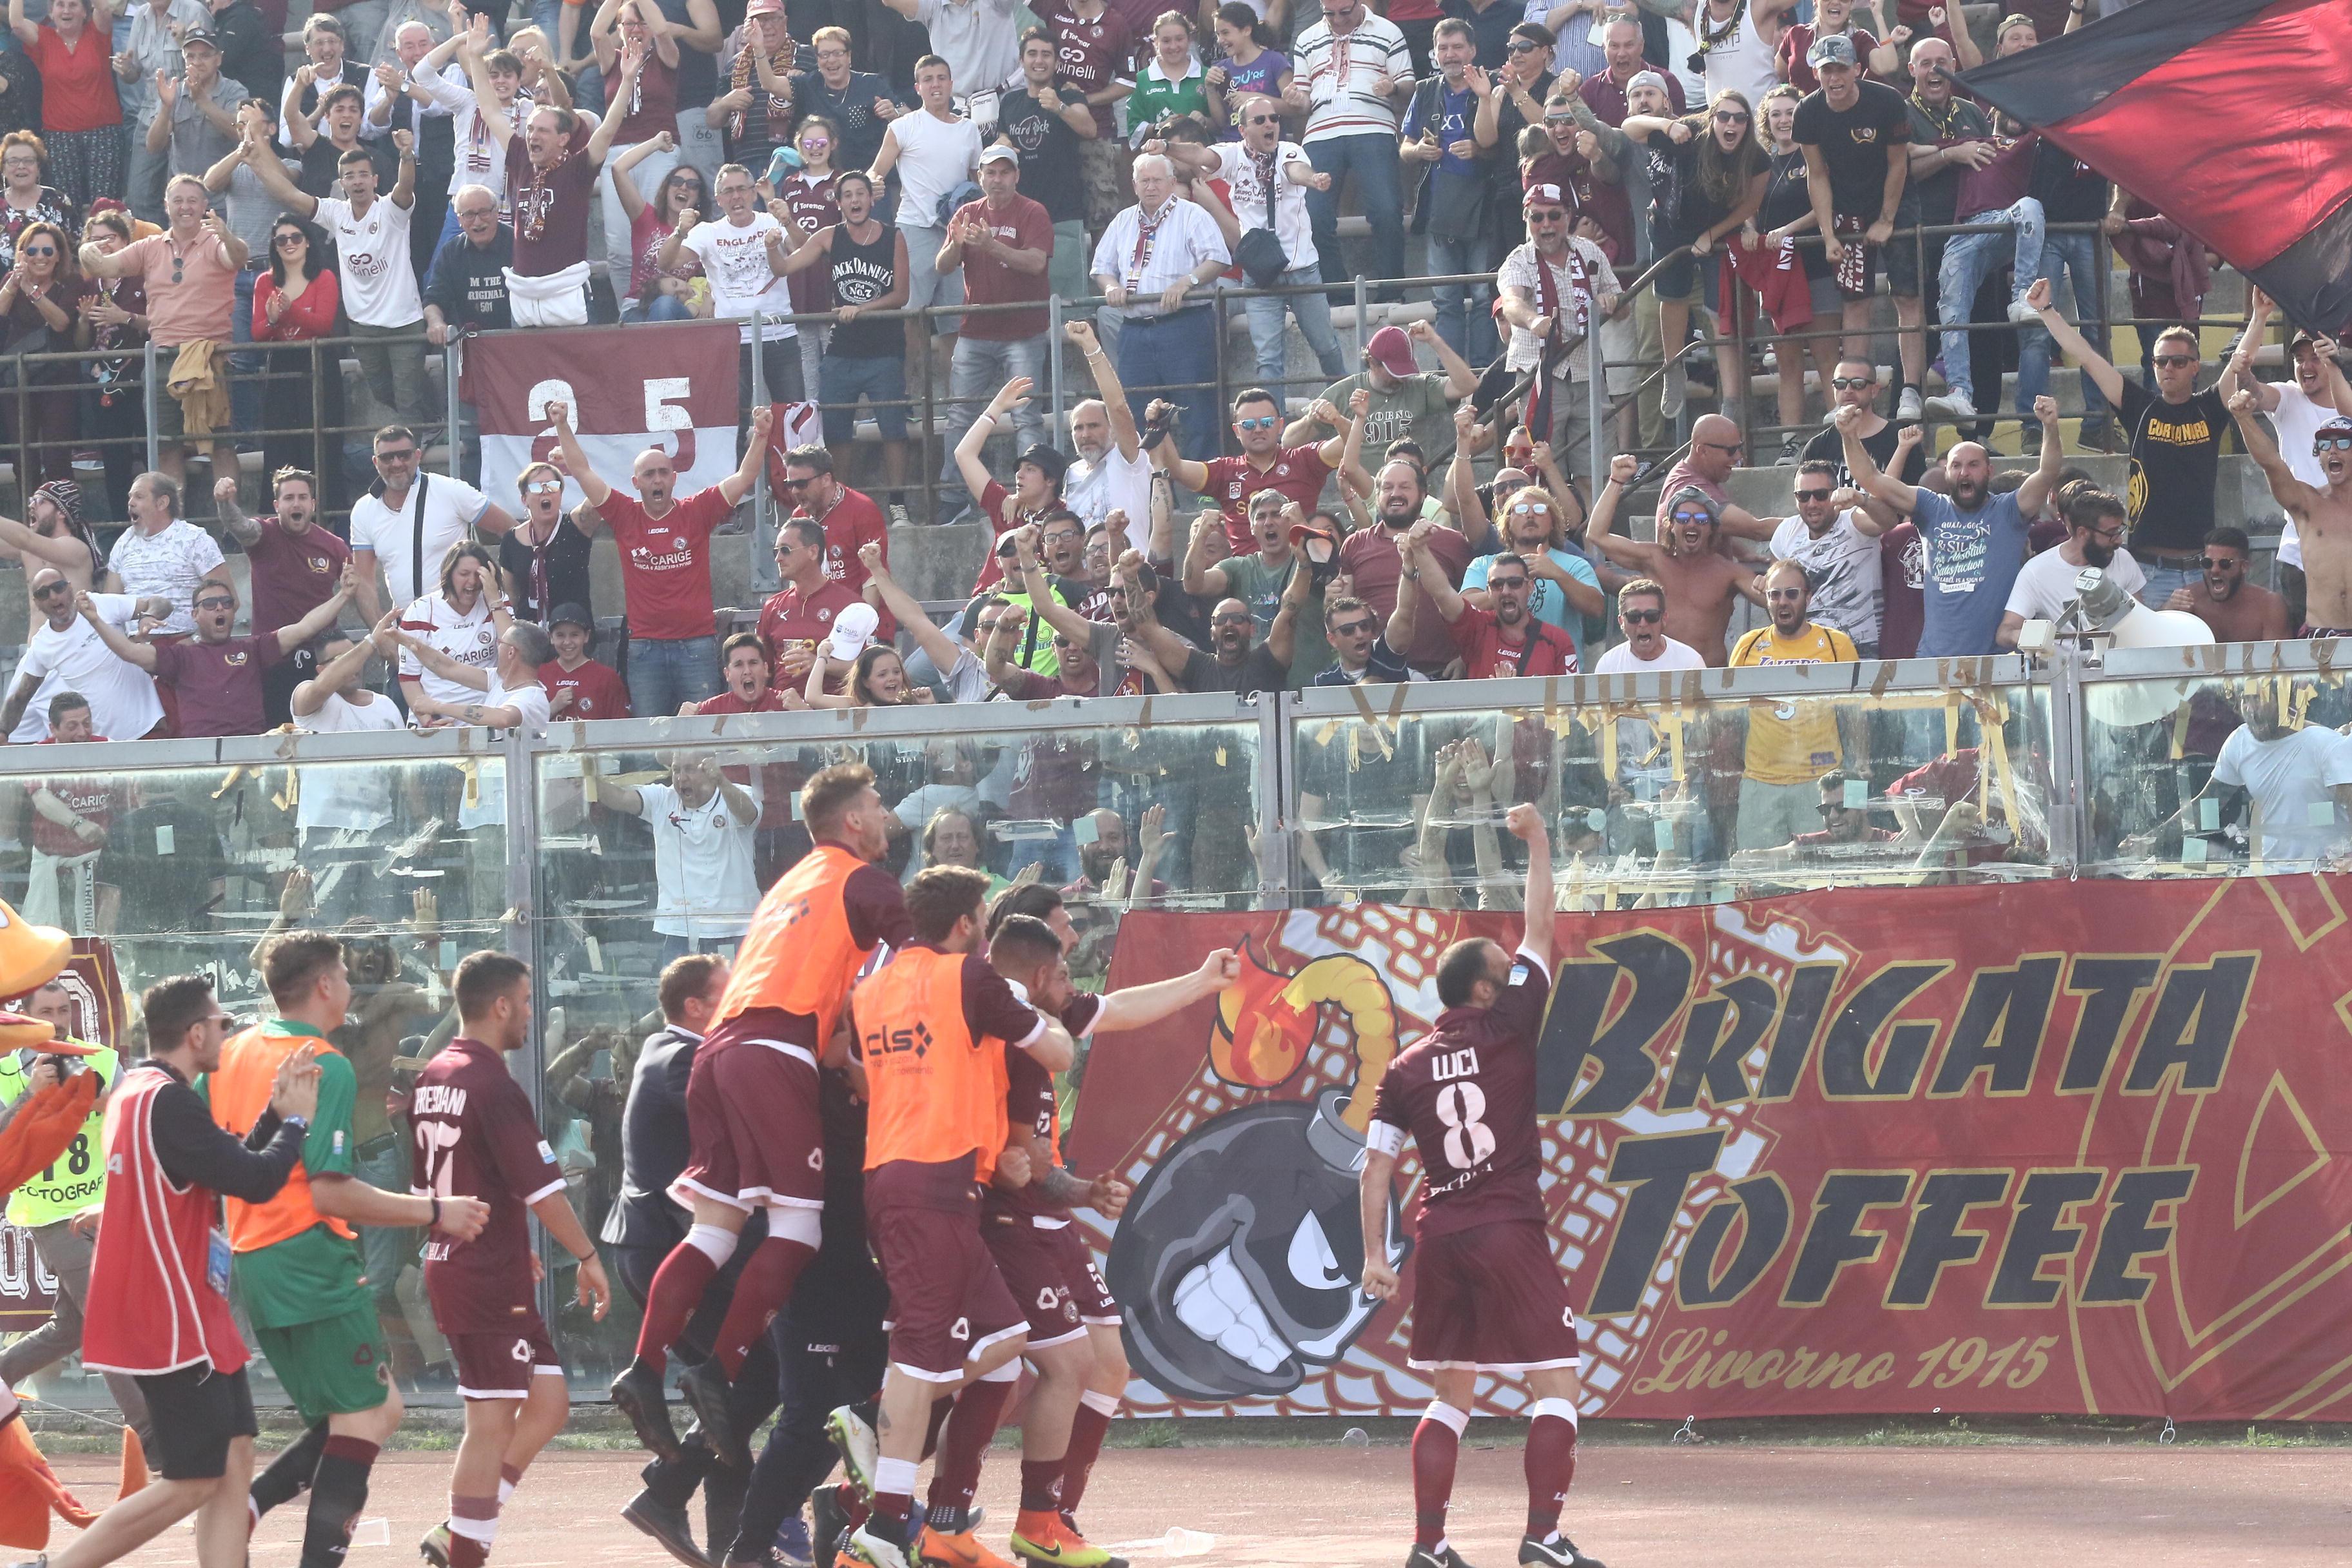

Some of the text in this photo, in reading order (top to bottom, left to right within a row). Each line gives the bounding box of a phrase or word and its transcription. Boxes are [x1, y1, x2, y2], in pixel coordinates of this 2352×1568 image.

[1068, 32, 1091, 48] Tormar
[1055, 59, 1096, 81] pinelli
[696, 130, 712, 140] 66
[1009, 121, 1032, 136] Hard
[799, 202, 826, 211] Toremar
[831, 260, 854, 282] JACK
[483, 275, 502, 287] THE
[467, 289, 505, 301] RIGINAL
[480, 301, 493, 313] 501
[1947, 539, 1978, 553] SILK
[650, 549, 692, 565] CARIGE
[455, 645, 495, 664] CARIGE
[1497, 648, 1522, 658] LEGEA
[1536, 927, 2261, 1120] BRIGATA
[867, 1024, 913, 1056] cls
[1432, 1046, 1480, 1082] LUCI
[1436, 1081, 1496, 1170] 8
[1583, 1124, 2200, 1321] TOFFEE
[1632, 1327, 2059, 1396] Livorno 1915
